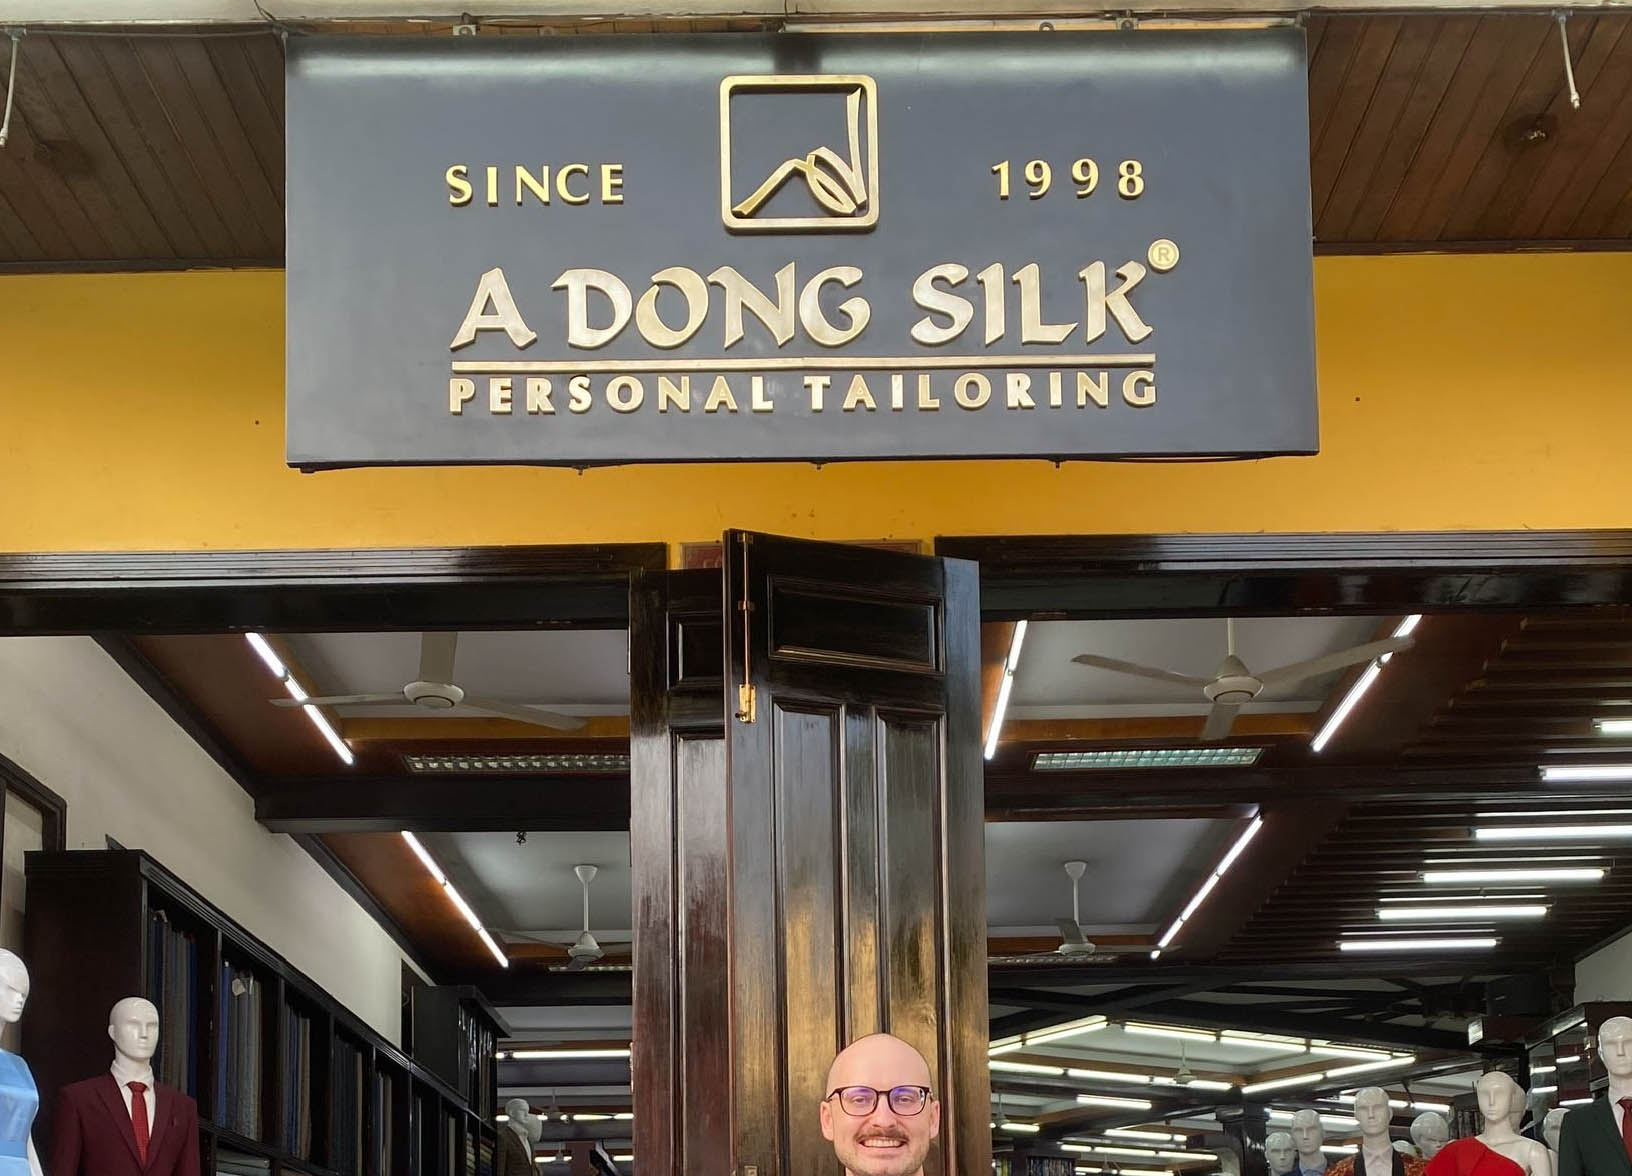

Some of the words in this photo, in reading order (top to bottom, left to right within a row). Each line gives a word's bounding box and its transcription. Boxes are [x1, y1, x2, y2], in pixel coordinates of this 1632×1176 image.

[445, 163, 624, 207] SINCE
[990, 158, 1146, 200] 1998
[448, 266, 538, 354] A
[550, 261, 872, 352] DONG
[910, 260, 1155, 350] SILK
[448, 375, 774, 416] PERSONAL
[804, 370, 1157, 412] TAILORING
